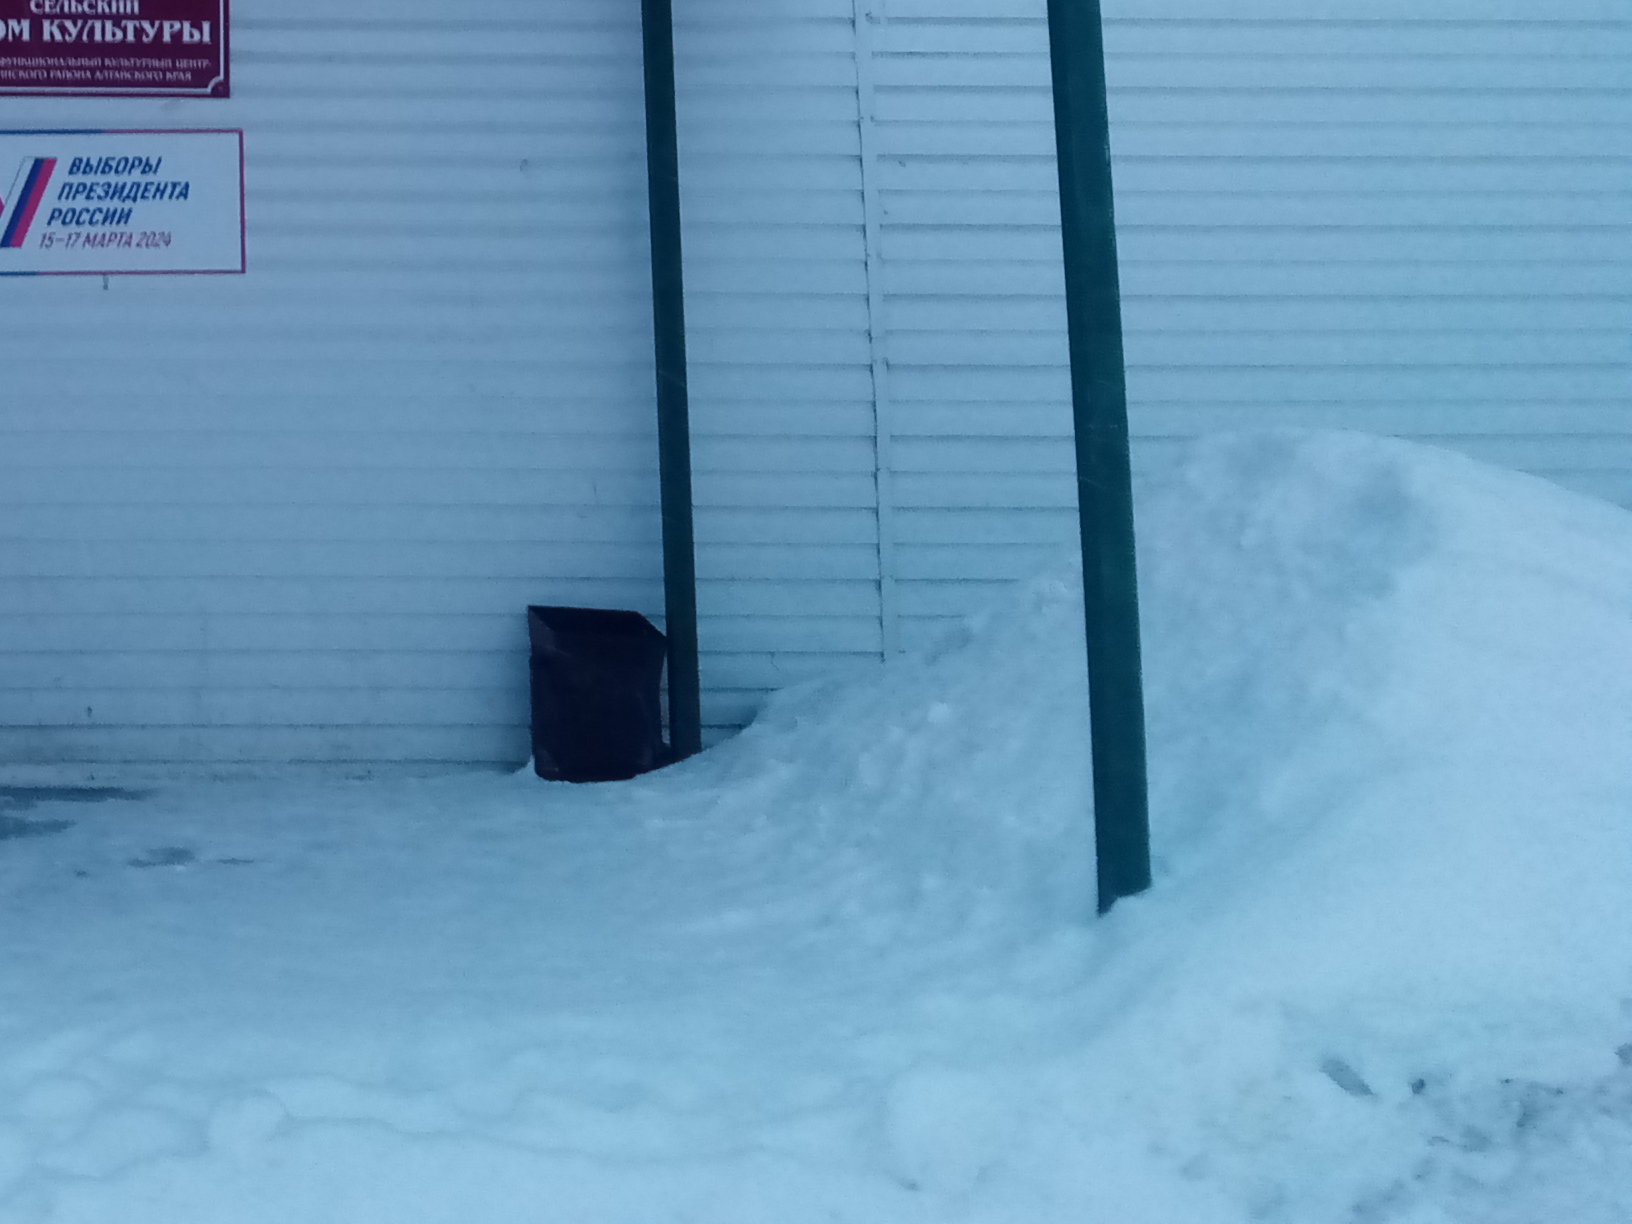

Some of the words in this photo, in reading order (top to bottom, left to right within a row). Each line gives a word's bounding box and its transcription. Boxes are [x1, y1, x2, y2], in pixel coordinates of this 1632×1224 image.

[42, 19, 212, 45] КУЛЬТУРЫ
[68, 156, 162, 176] ВЫБОРЫ
[57, 181, 191, 203] ПРЕЗИДЕНТА
[46, 207, 133, 227] РОССИИ
[81, 232, 133, 249] МАРТА
[135, 231, 172, 248] 2024
